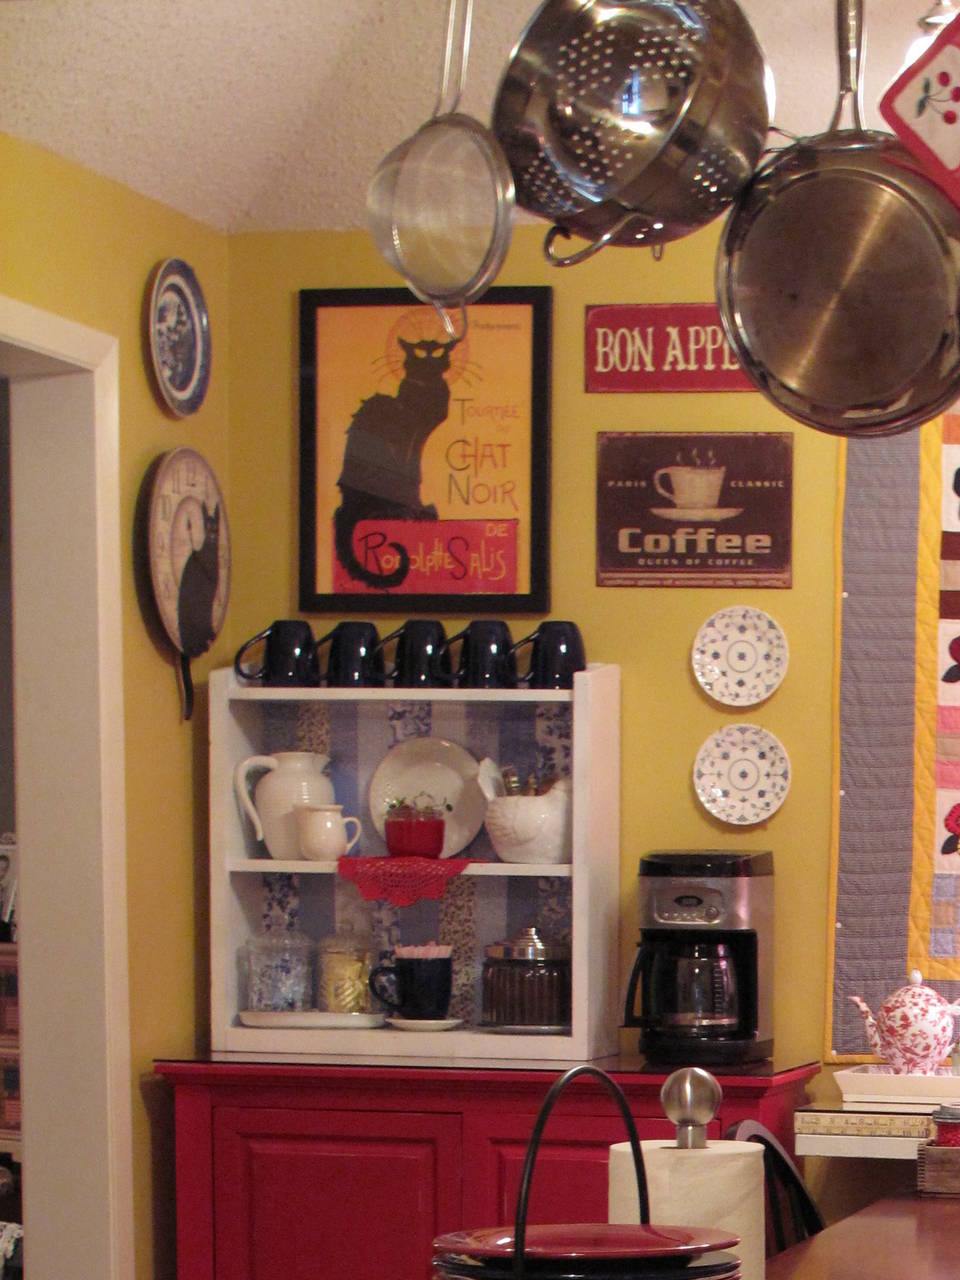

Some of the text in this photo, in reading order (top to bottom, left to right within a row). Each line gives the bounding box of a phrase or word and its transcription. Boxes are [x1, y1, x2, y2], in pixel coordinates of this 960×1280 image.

[594, 327, 656, 372] BON
[445, 436, 512, 479] CHAT
[448, 473, 519, 512] NOIR
[607, 480, 785, 488] PARIS CLASSIC
[486, 523, 508, 537] DE
[617, 527, 772, 554] Coffee
[638, 558, 754, 566] QUEEN OF COFFEE
